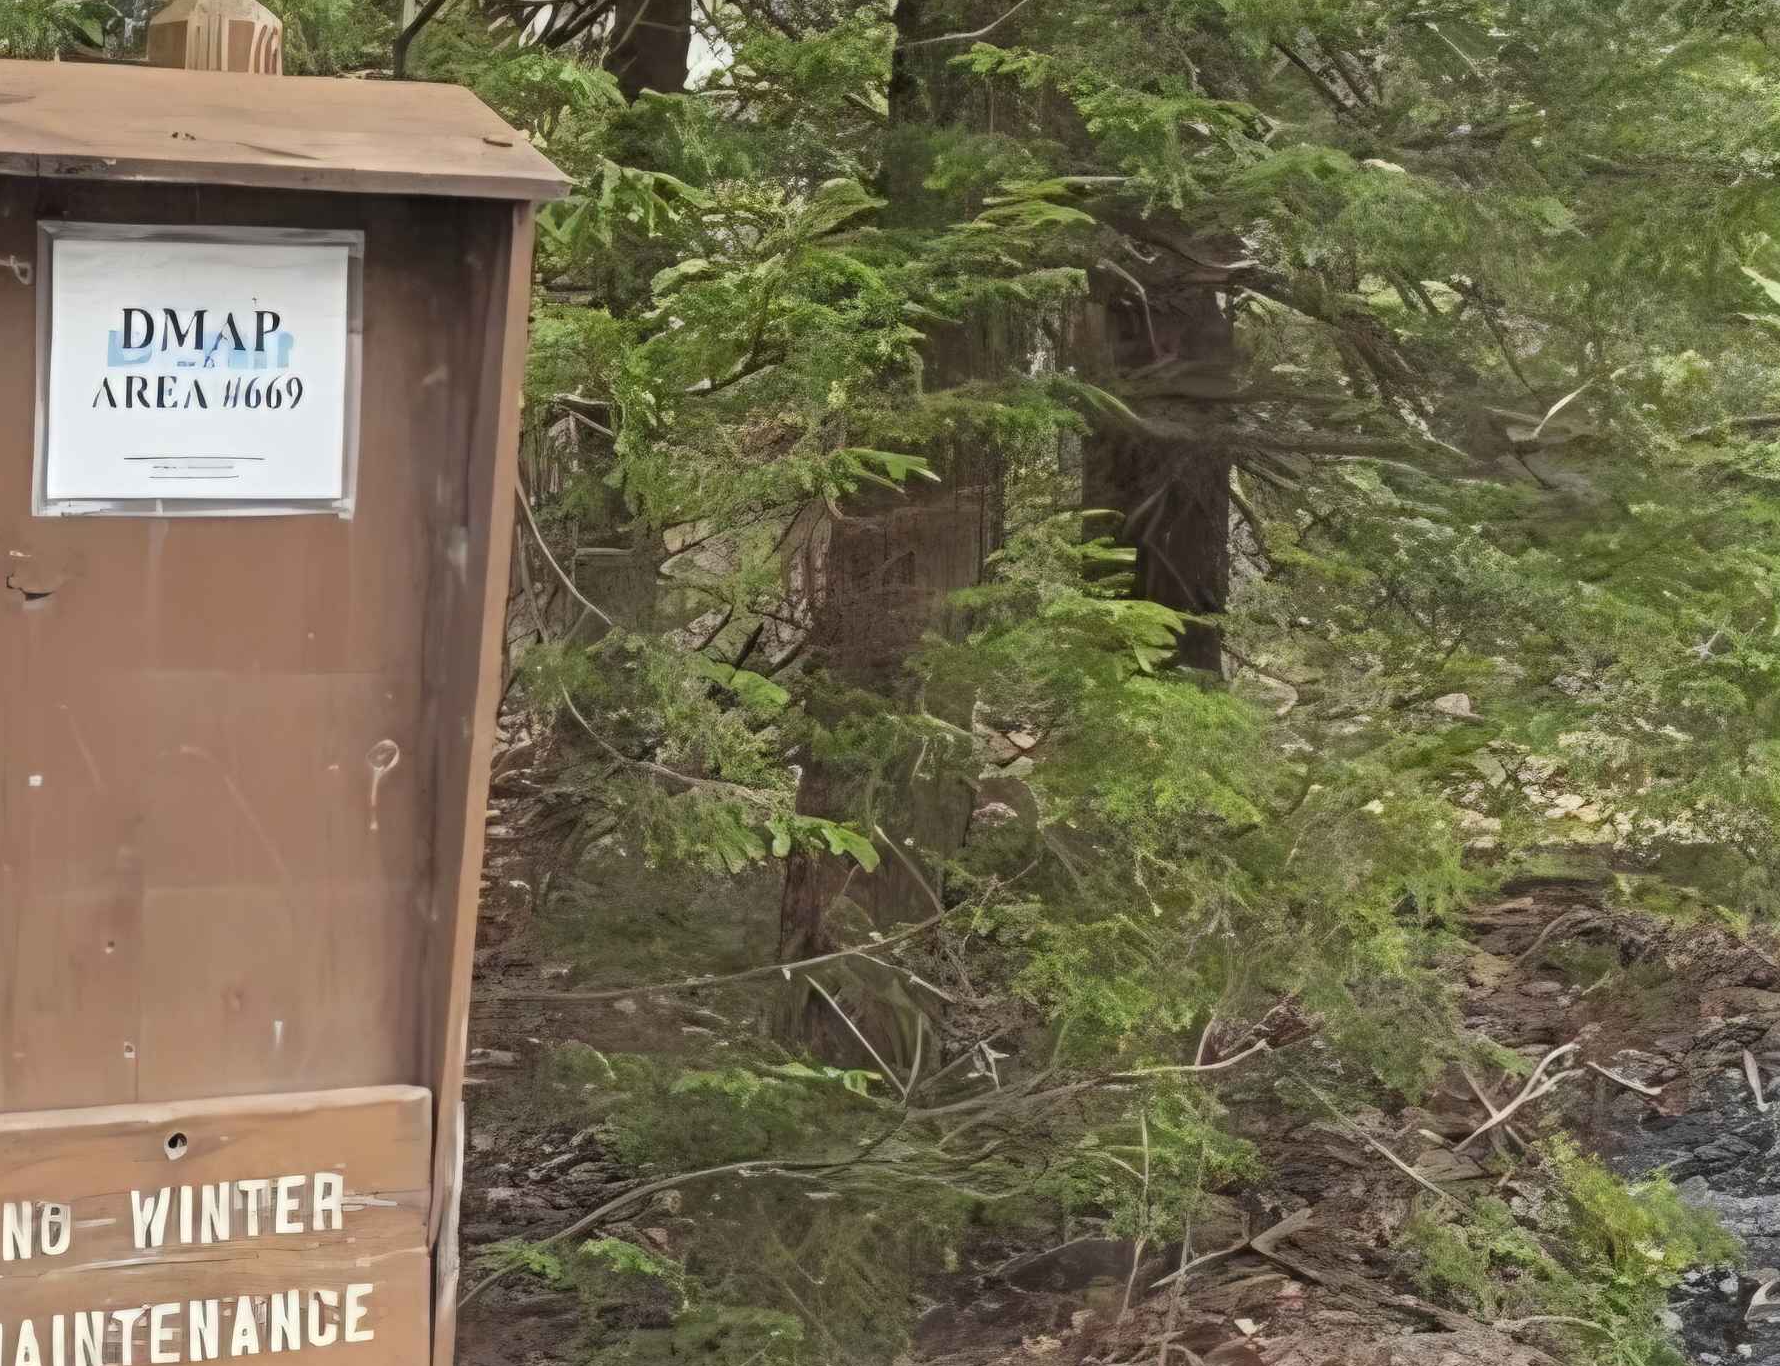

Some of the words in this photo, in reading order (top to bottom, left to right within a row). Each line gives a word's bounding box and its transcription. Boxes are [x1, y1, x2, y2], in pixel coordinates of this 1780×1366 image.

[121, 307, 282, 354] DMAP
[92, 375, 208, 409] AREA
[130, 1171, 344, 1249] WINTER
